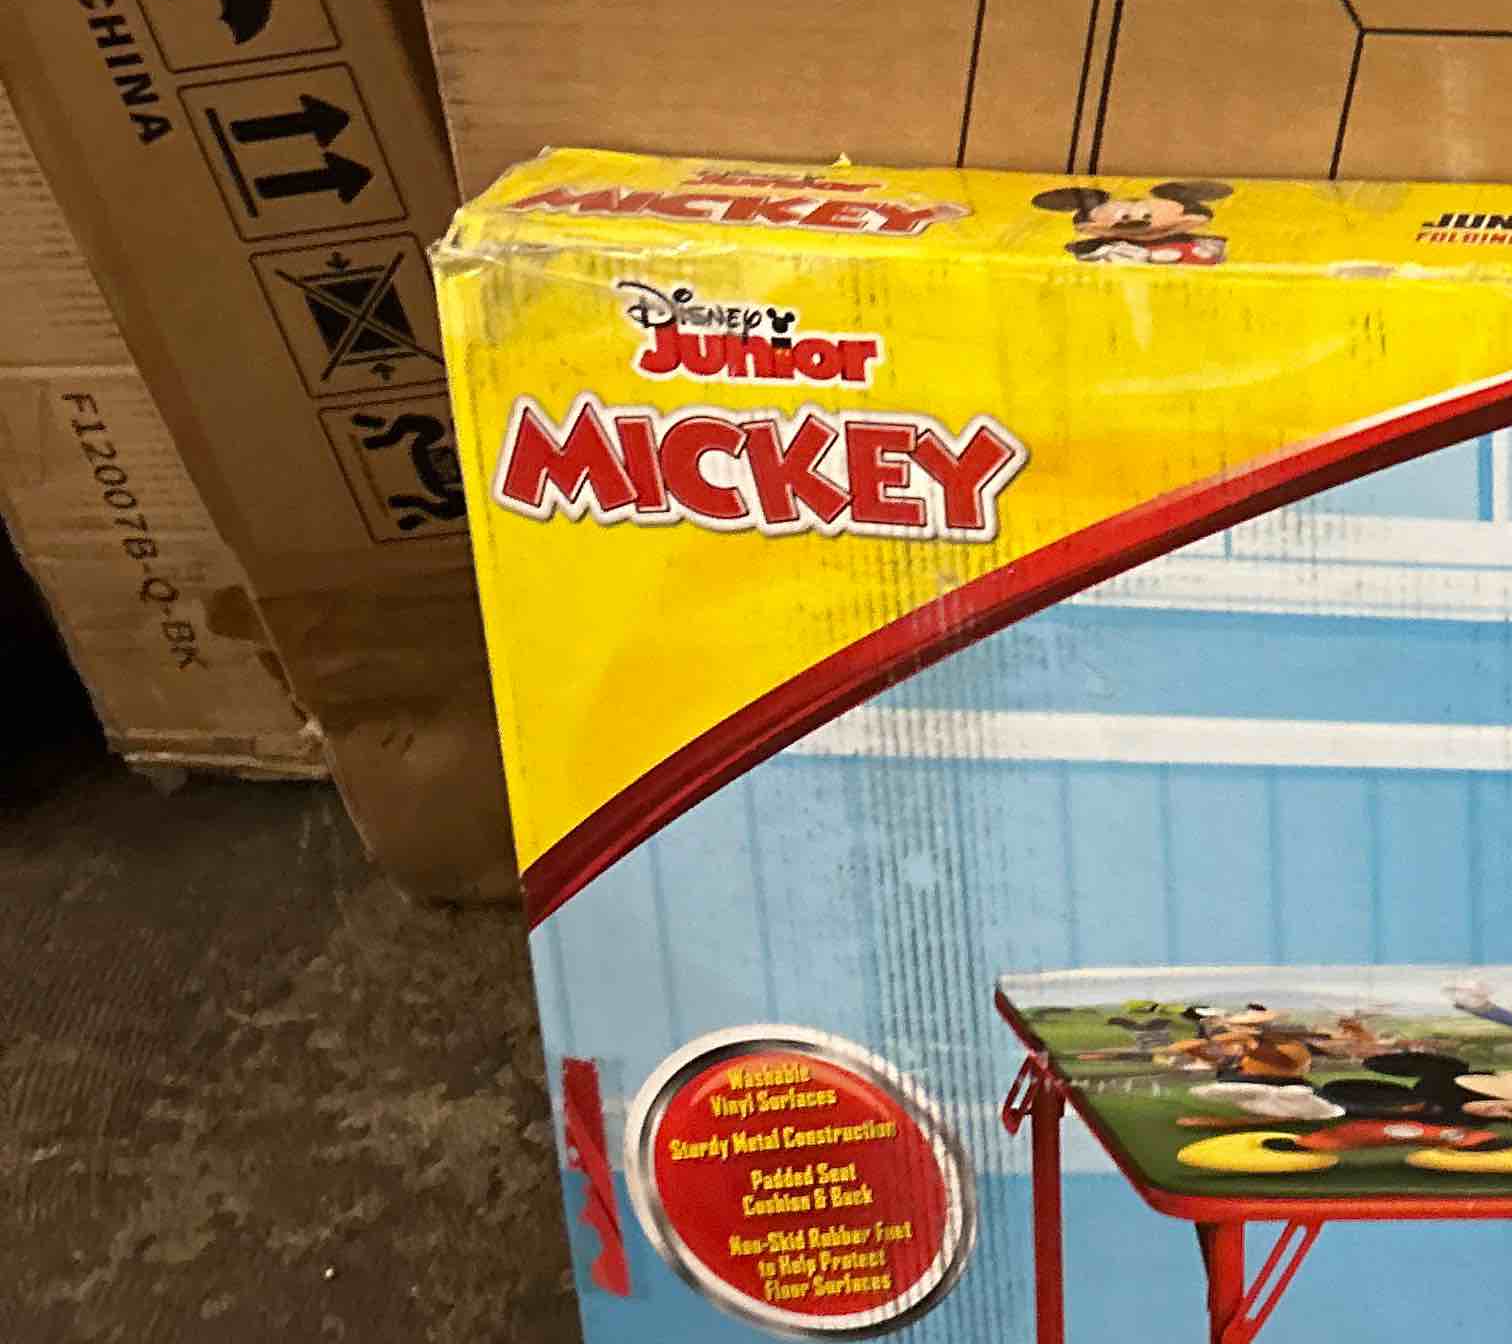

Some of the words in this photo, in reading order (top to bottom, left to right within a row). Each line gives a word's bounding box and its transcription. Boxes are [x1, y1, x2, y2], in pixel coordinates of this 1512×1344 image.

[506, 187, 970, 235] MICKEY
[500, 402, 1018, 533] MICKEY
[727, 1062, 813, 1090] Washable
[710, 1093, 754, 1119] Vinyl
[756, 1087, 837, 1112] Surfaces
[670, 1135, 729, 1160] Sturdy
[731, 1127, 780, 1154] Metal
[782, 1119, 898, 1149] Construction
[751, 1165, 814, 1190] Padded
[816, 1162, 857, 1184] Seat
[742, 1191, 811, 1217] Cushion
[813, 1187, 826, 1210] &
[829, 1182, 874, 1207] Back
[729, 1229, 806, 1256] Non-Skid
[808, 1224, 871, 1249] Rubber
[778, 1254, 817, 1278] Help
[818, 1248, 886, 1272] Protect
[763, 1276, 809, 1302] Floor
[812, 1270, 893, 1297] Surfaces
